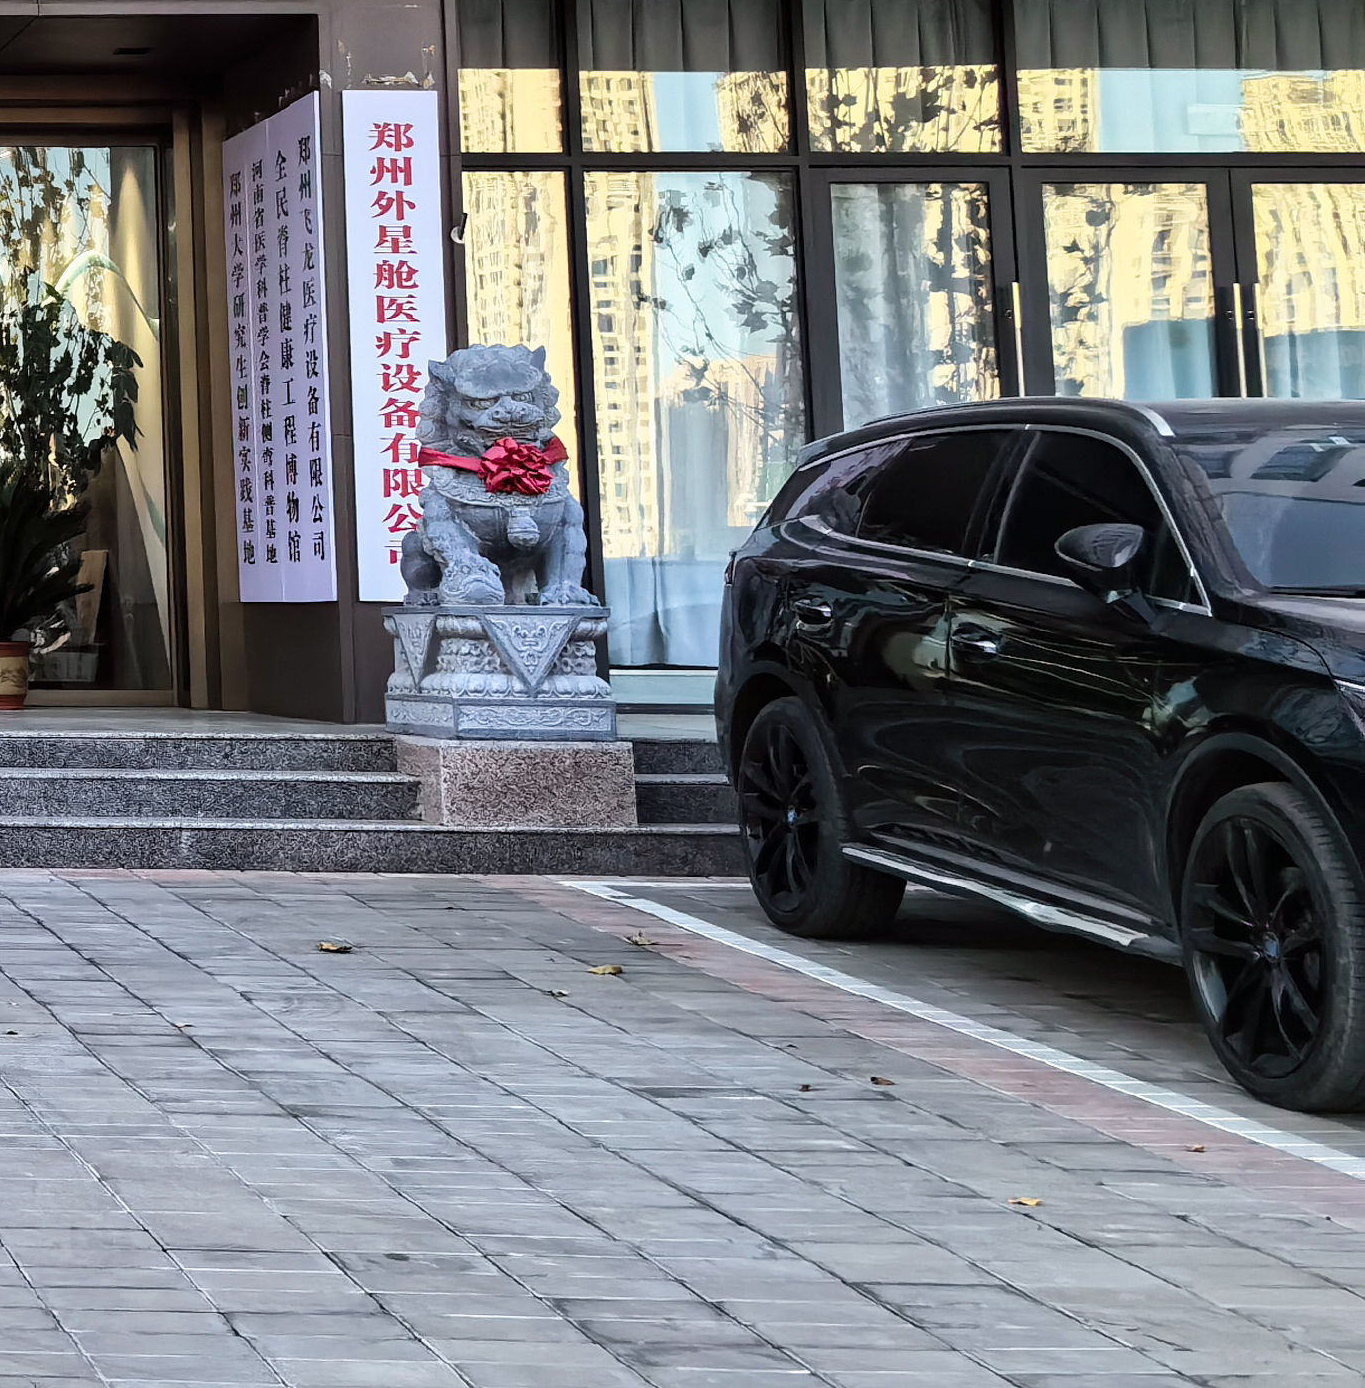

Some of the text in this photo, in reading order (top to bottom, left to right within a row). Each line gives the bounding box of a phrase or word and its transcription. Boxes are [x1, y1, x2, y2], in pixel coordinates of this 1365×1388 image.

[229, 170, 257, 565] 郑州大学研究生创新实践基地
[274, 149, 302, 564] 全民脊柱健康工程博物馆
[297, 135, 326, 561] 郑州飞龙医疗设备有限公司
